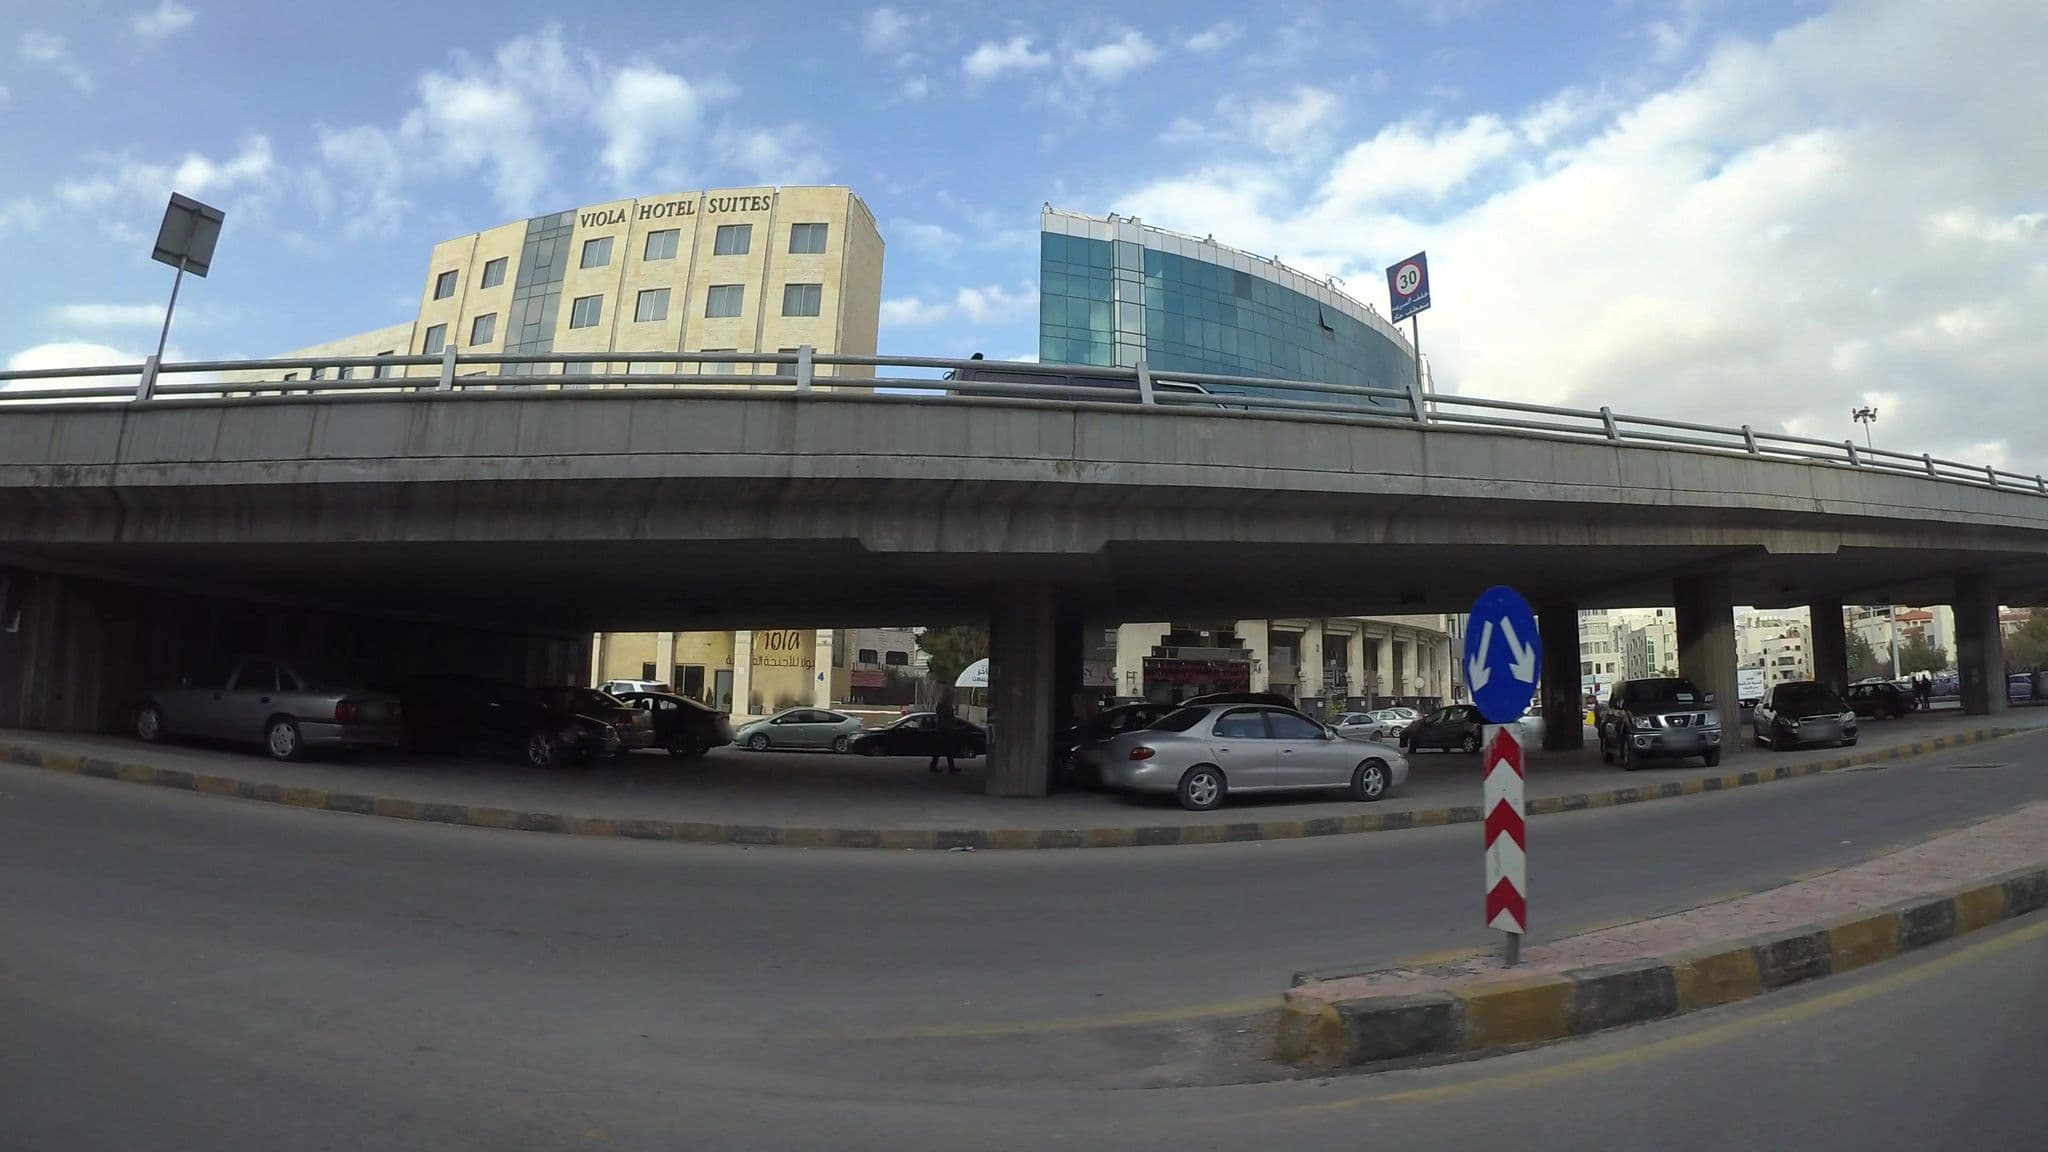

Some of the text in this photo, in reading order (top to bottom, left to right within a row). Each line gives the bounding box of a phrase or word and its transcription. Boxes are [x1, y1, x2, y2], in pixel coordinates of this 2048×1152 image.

[580, 195, 771, 228] VIOLA HOTEL SUITES
[1399, 270, 1417, 289] 30
